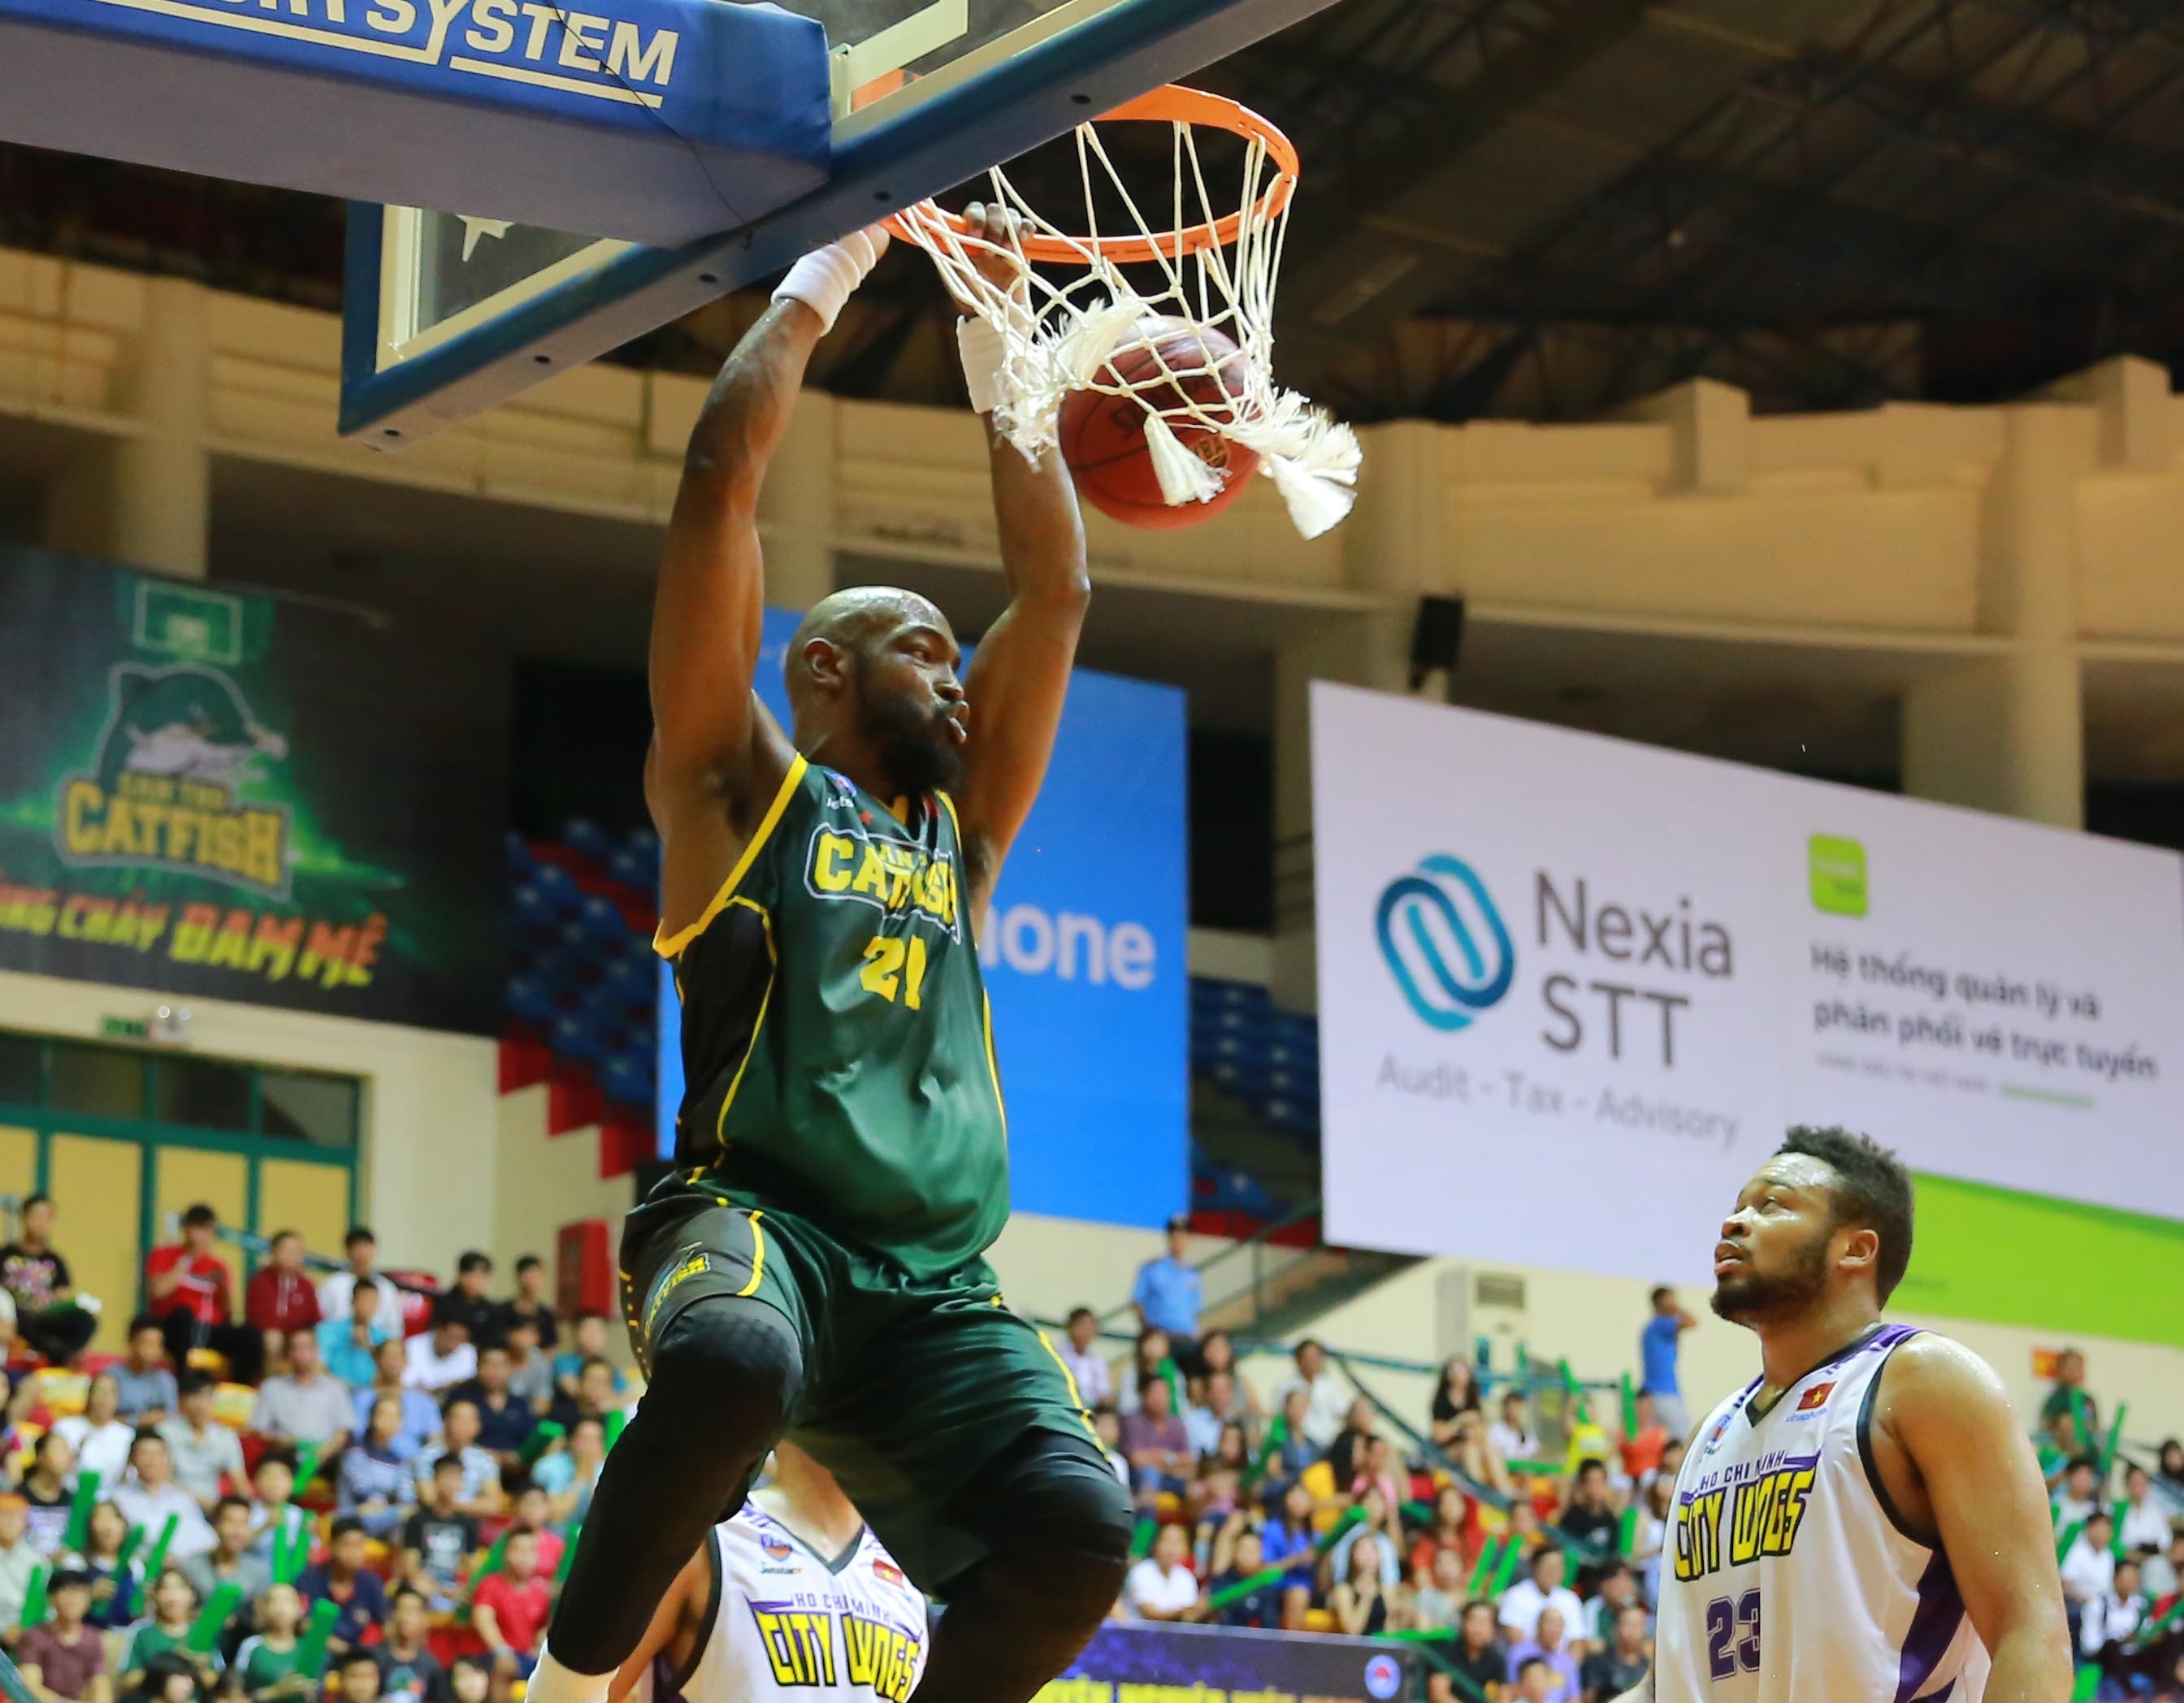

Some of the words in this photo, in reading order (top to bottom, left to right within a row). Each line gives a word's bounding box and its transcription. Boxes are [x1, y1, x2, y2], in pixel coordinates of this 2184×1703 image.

[64, 780, 284, 886] CATFISH
[1535, 871, 1734, 978] Nexia
[860, 936, 927, 1010] 21
[1541, 974, 1690, 1069] STT
[1378, 1054, 1469, 1103] Audit
[1501, 1068, 1562, 1116] Tax
[1595, 1088, 1740, 1148] Advisory
[1700, 1471, 1718, 1490] HO
[1723, 1462, 1750, 1483] CHI
[1730, 1466, 1818, 1567] WNGS
[795, 1592, 817, 1608] HO
[823, 1593, 850, 1610] CHI
[1706, 1588, 1761, 1683] 23
[753, 1610, 838, 1687] CITY
[840, 1612, 921, 1703] WNGS
